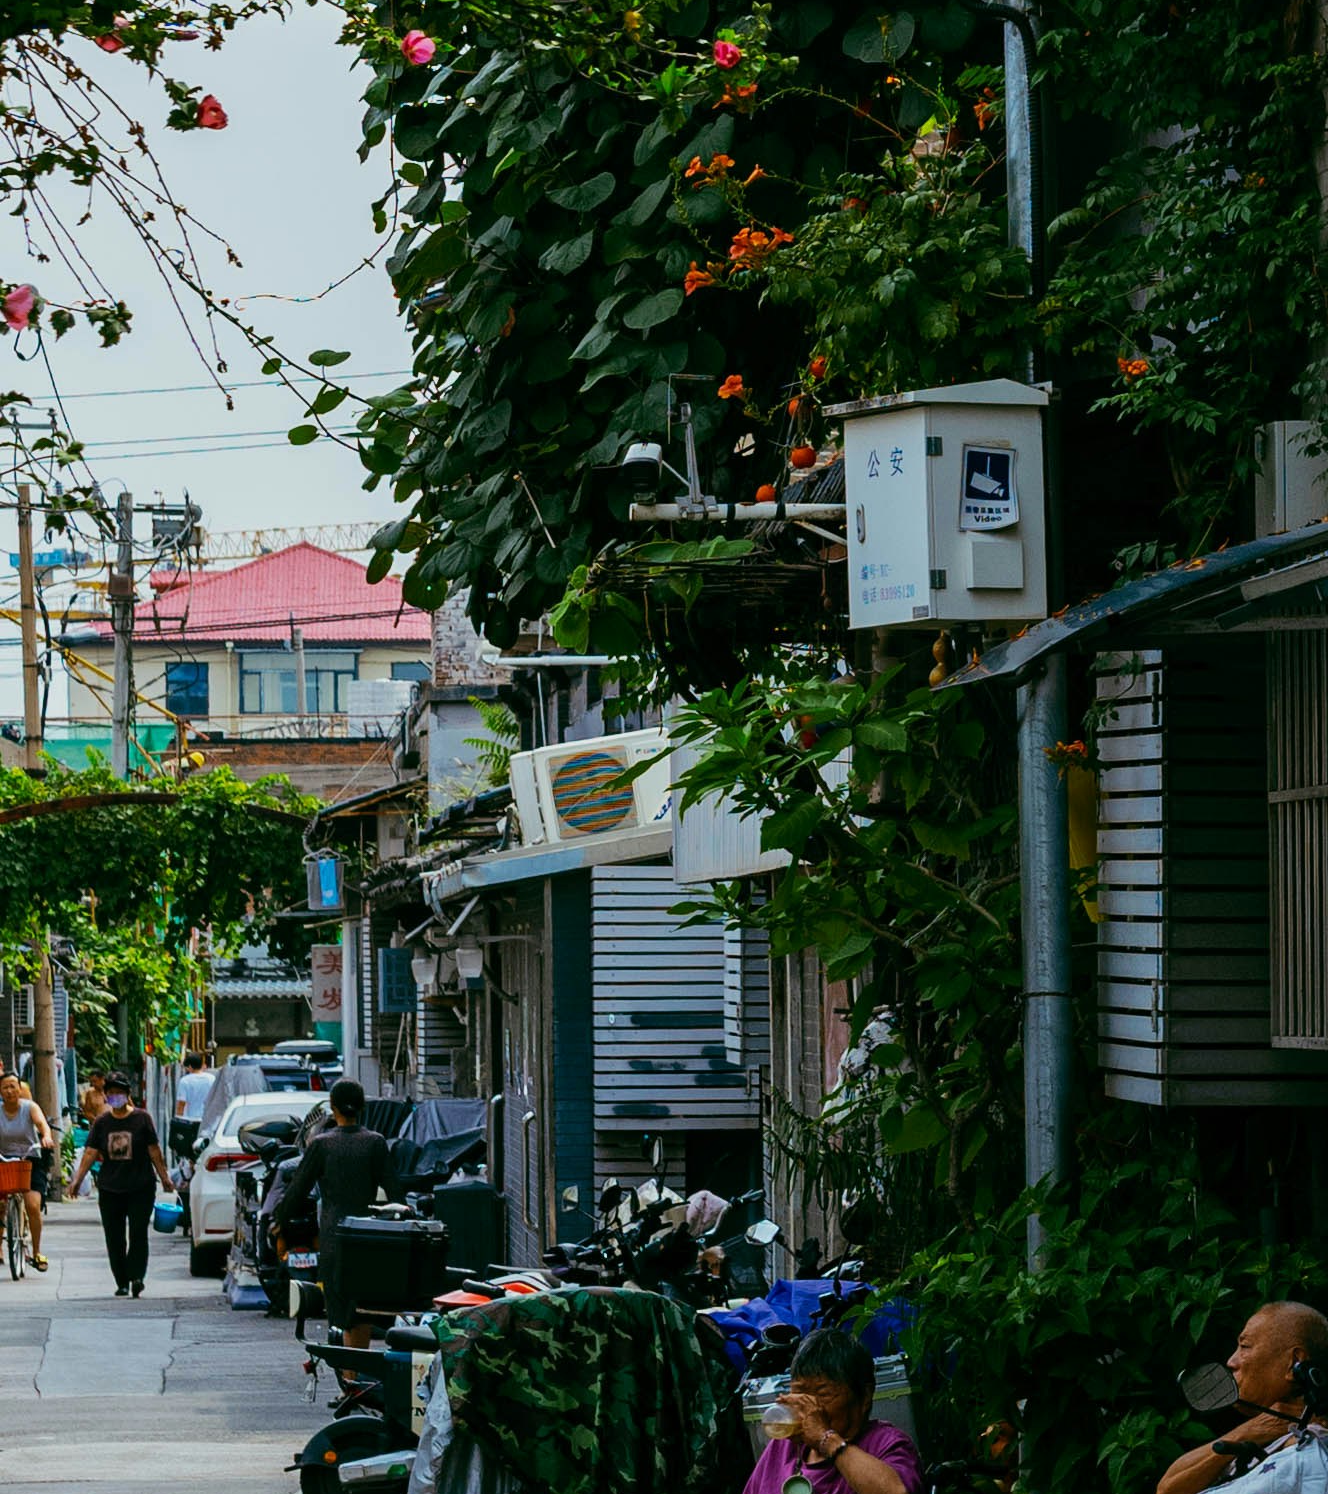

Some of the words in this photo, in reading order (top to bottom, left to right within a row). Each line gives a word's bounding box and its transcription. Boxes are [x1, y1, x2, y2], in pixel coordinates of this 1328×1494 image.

[867, 446, 904, 478] 公安
[974, 514, 1003, 523] Video
[316, 950, 342, 1010] 美发
